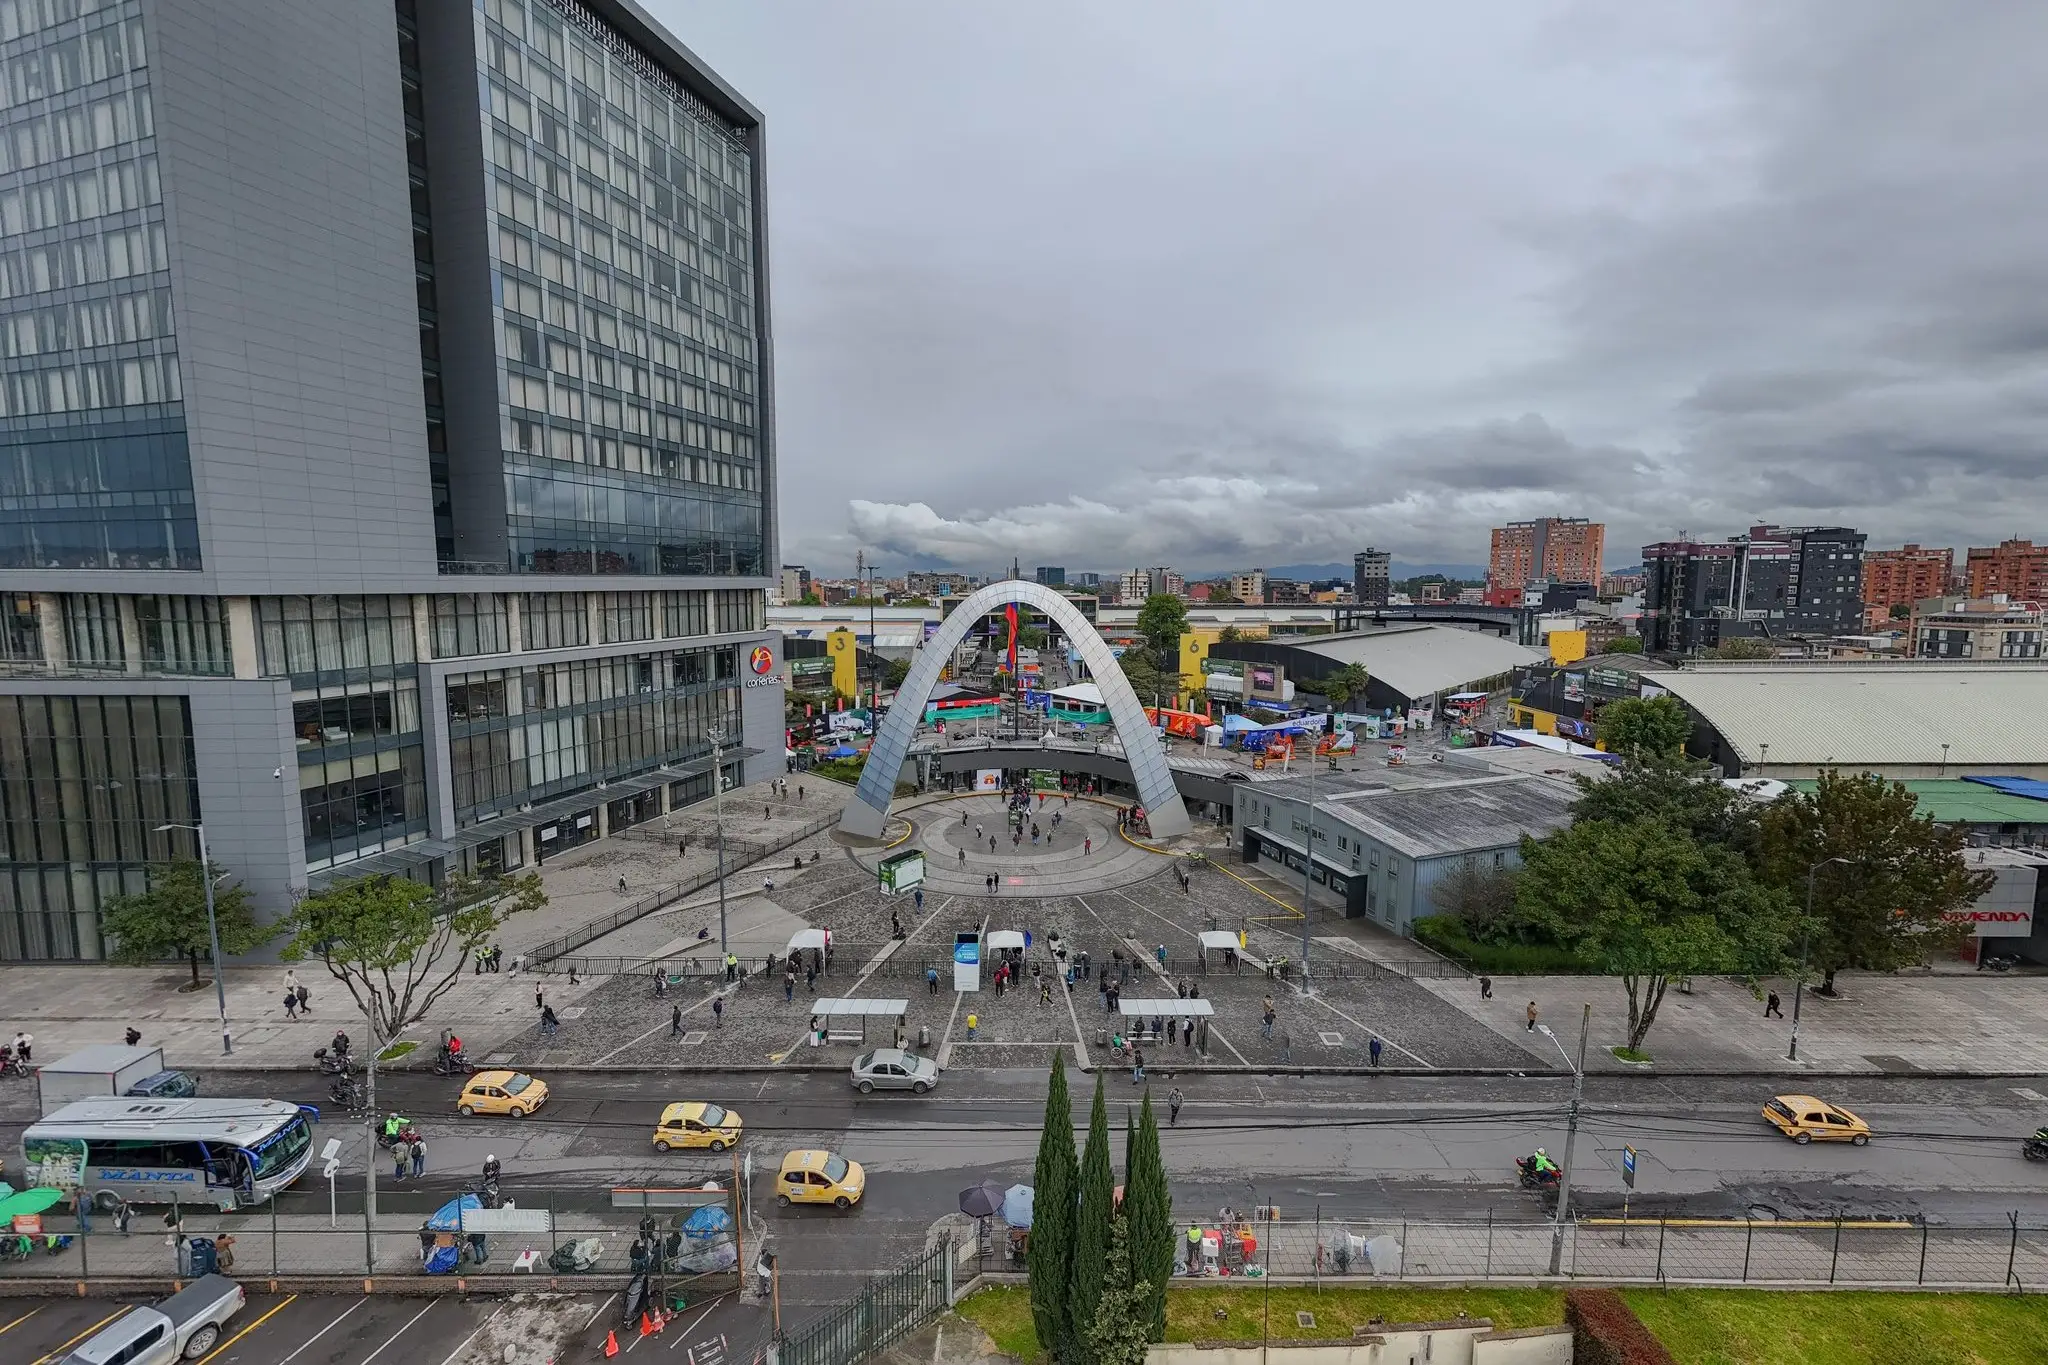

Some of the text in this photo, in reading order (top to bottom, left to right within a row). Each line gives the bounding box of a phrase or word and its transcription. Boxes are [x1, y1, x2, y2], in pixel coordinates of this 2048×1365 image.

[835, 638, 846, 651] 3
[916, 640, 924, 651] 4
[1190, 640, 1199, 653] 6
[747, 676, 778, 688] corferias
[97, 1170, 196, 1182] MANTA
